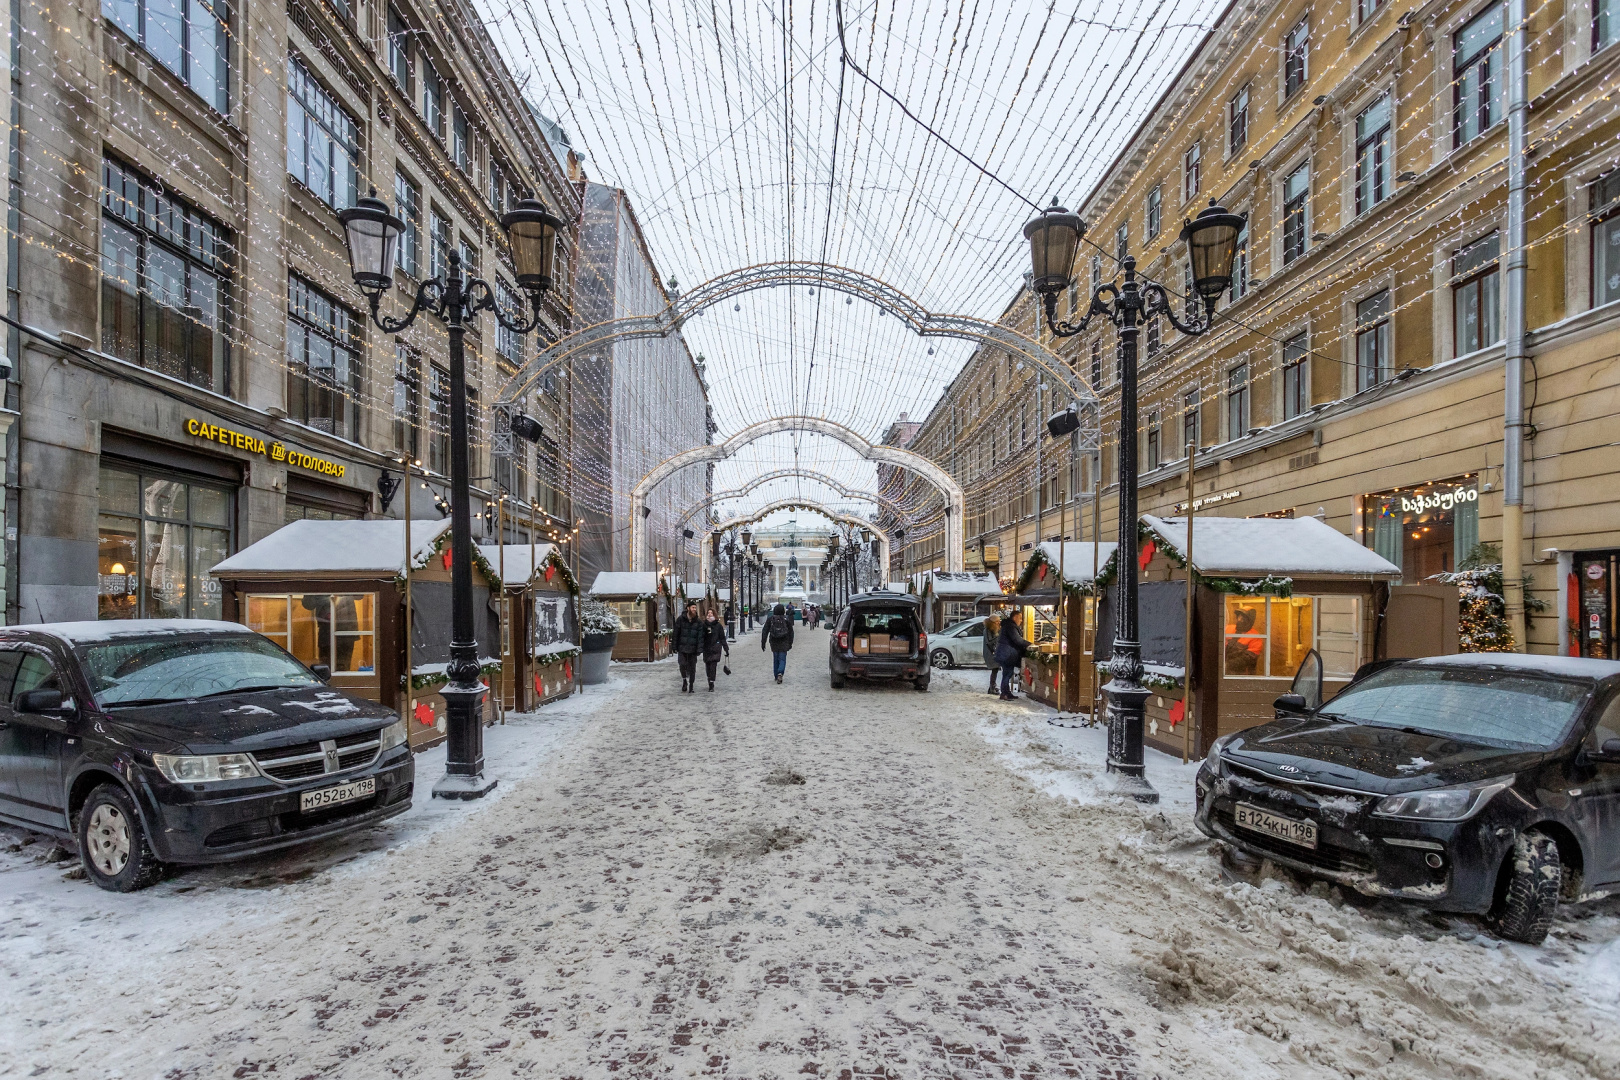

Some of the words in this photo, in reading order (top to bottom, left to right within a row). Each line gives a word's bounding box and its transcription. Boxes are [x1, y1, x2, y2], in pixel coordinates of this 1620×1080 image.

[187, 419, 267, 455] CAFETERIA
[288, 450, 346, 478] СТОЛОВАЯ
[1279, 764, 1295, 772] KIA
[356, 779, 373, 792] 198
[1292, 823, 1313, 839] 198
